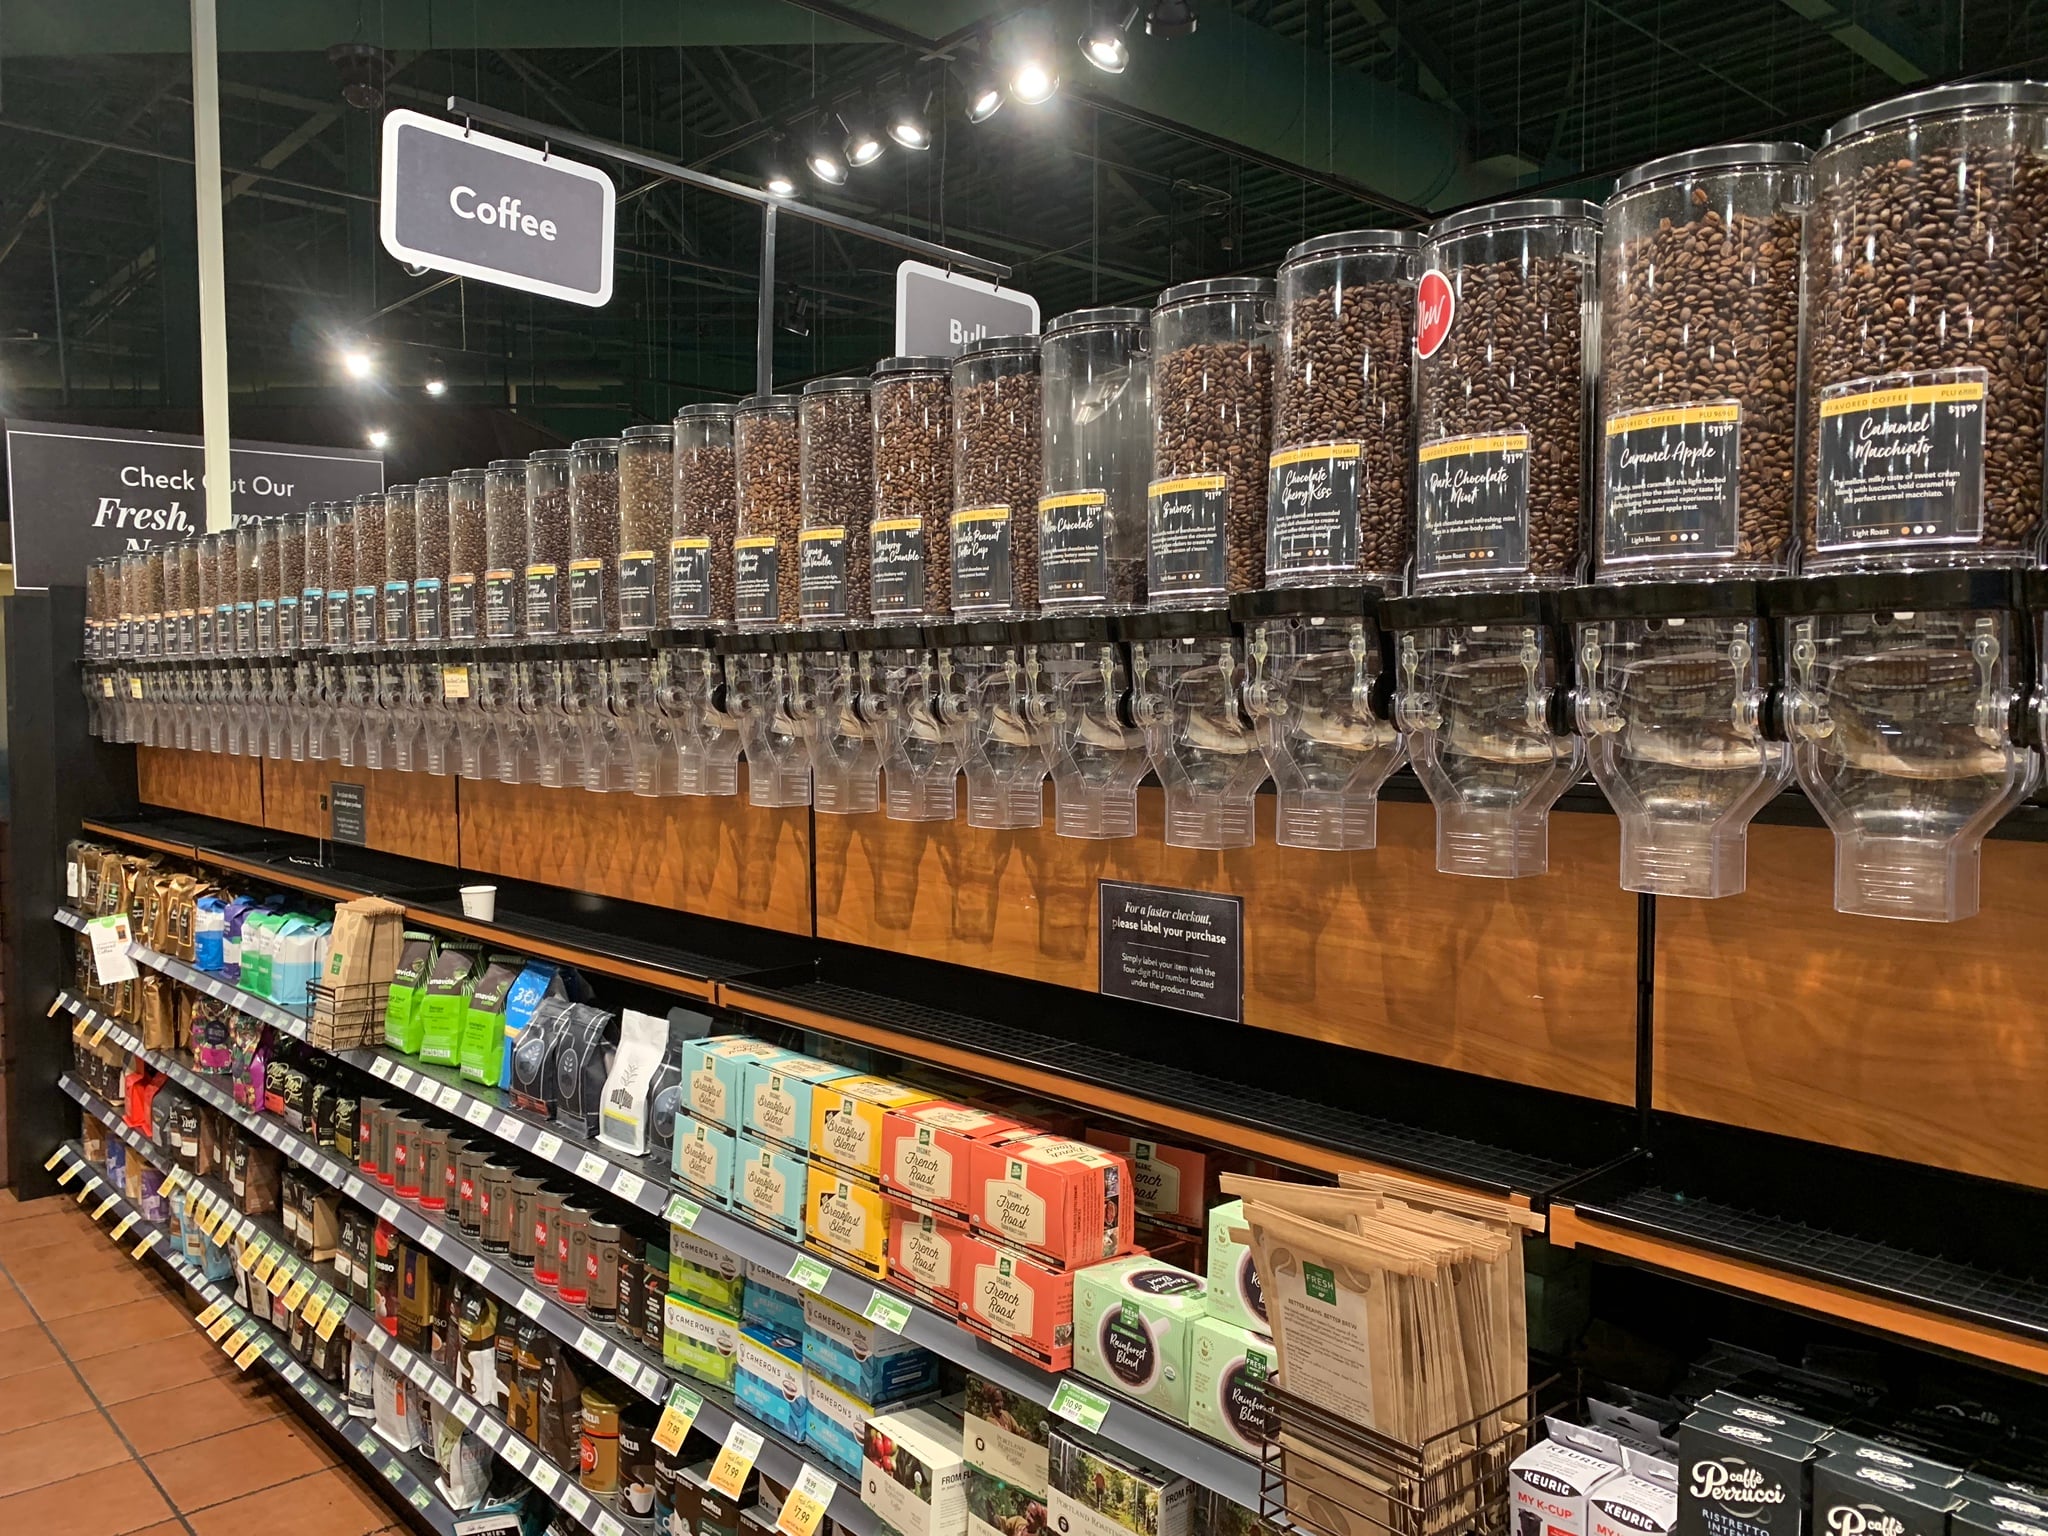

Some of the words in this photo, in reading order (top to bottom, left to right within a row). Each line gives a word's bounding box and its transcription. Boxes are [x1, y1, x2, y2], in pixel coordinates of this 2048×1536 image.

[448, 185, 559, 242] Coffee
[1418, 295, 1446, 339] New
[950, 318, 986, 344] Bul
[1825, 399, 1868, 412] FLAVORED
[1872, 394, 1908, 404] COFFEE
[1941, 390, 1957, 398] PLU
[1646, 415, 1676, 425] COFFEE
[1860, 413, 1930, 440] Caramel
[1620, 444, 1672, 469] Caramel
[1672, 441, 1716, 467] Apple
[1855, 435, 1934, 465] Macchiato
[120, 466, 195, 491] Check
[252, 475, 294, 497] Our
[1285, 467, 1328, 487] Chocolate
[1430, 472, 1452, 492] Dark
[1454, 466, 1509, 488] Chocolate
[1868, 475, 1886, 484] milky
[1887, 474, 1904, 482] taste
[1905, 472, 1913, 480] of
[1914, 471, 1936, 479] sweet
[1937, 470, 1960, 478] cream
[1898, 481, 1914, 489] bold
[1915, 480, 1944, 488] caramel
[1945, 479, 1957, 487] for
[1282, 487, 1308, 506] Cherry
[1309, 482, 1333, 501] Kiss
[1450, 486, 1480, 509] Mint
[1652, 496, 1678, 504] autumnal
[1679, 495, 1713, 503] experience
[1854, 494, 1876, 504] perfect
[1877, 493, 1904, 501] caramel
[1905, 490, 1943, 499] macchiato.
[92, 497, 196, 534] Fresh,
[1057, 516, 1094, 533] Chocolate
[1631, 536, 1644, 545] Light
[1645, 535, 1661, 543] Roast
[1852, 529, 1869, 539] Light
[1870, 527, 1890, 536] Roast
[1124, 901, 1139, 914] For
[1146, 905, 1171, 919] faster
[1171, 908, 1212, 926] checkout,
[1112, 918, 1139, 931] please
[1140, 920, 1162, 935] label
[1163, 925, 1183, 939] your
[1185, 929, 1227, 944] purchase
[1121, 952, 1142, 965] Simply
[1142, 956, 1158, 967] label
[1158, 961, 1173, 971] your
[1174, 962, 1188, 972] item
[1189, 963, 1203, 975] with
[1204, 967, 1216, 978] the
[1122, 964, 1151, 979] four-digit
[1152, 969, 1164, 979] PLU
[1165, 972, 1189, 984] number
[1190, 975, 1214, 989] located
[1131, 978, 1148, 989] under
[1149, 981, 1160, 991] the
[1161, 983, 1185, 996] product
[1186, 989, 1206, 1000] name.
[693, 1078, 722, 1098] Breakfast
[698, 1093, 715, 1108] Blend
[757, 1095, 791, 1116] Breakfast
[763, 1110, 784, 1126] Blend
[827, 1119, 865, 1142] Breakfast
[684, 1144, 714, 1164] Breakfast
[833, 1136, 857, 1153] Blend
[689, 1158, 707, 1174] Blend
[905, 1152, 939, 1172] French
[747, 1170, 781, 1193] Breakfast
[909, 1165, 936, 1186] Roast
[1135, 1172, 1162, 1187] ench
[753, 1187, 773, 1203] Blend
[822, 1201, 860, 1226] Breakfast
[997, 1195, 1030, 1217] French
[828, 1221, 852, 1238] Blend
[1001, 1209, 1027, 1230] Roast
[909, 1237, 940, 1259] French
[912, 1251, 936, 1273] Roast
[1306, 1274, 1334, 1290] FRESH
[984, 1281, 1020, 1306] French
[988, 1296, 1016, 1320] Roast
[1121, 1307, 1139, 1320] FRESH
[1109, 1333, 1148, 1360] Rainforest
[1116, 1349, 1140, 1372] Blend
[1246, 1358, 1266, 1371] FRESH
[1065, 1397, 1083, 1412] $10.99
[667, 1421, 680, 1435] $7.99
[1546, 1444, 1609, 1470] KEURIG
[724, 1462, 739, 1478] $7.99
[941, 1473, 962, 1485] FROM
[1729, 1468, 1765, 1489] caffè
[1523, 1470, 1571, 1496] KEURIG
[1689, 1461, 1786, 1504] Perrucci
[1165, 1491, 1185, 1505] FROM
[1518, 1492, 1535, 1506] MY
[1536, 1498, 1573, 1519] K-CUP
[794, 1505, 810, 1524] $7.99
[1604, 1502, 1655, 1531] KEURIG
[1702, 1508, 1770, 1536] RISTRETTO
[1866, 1516, 1906, 1534] caffè
